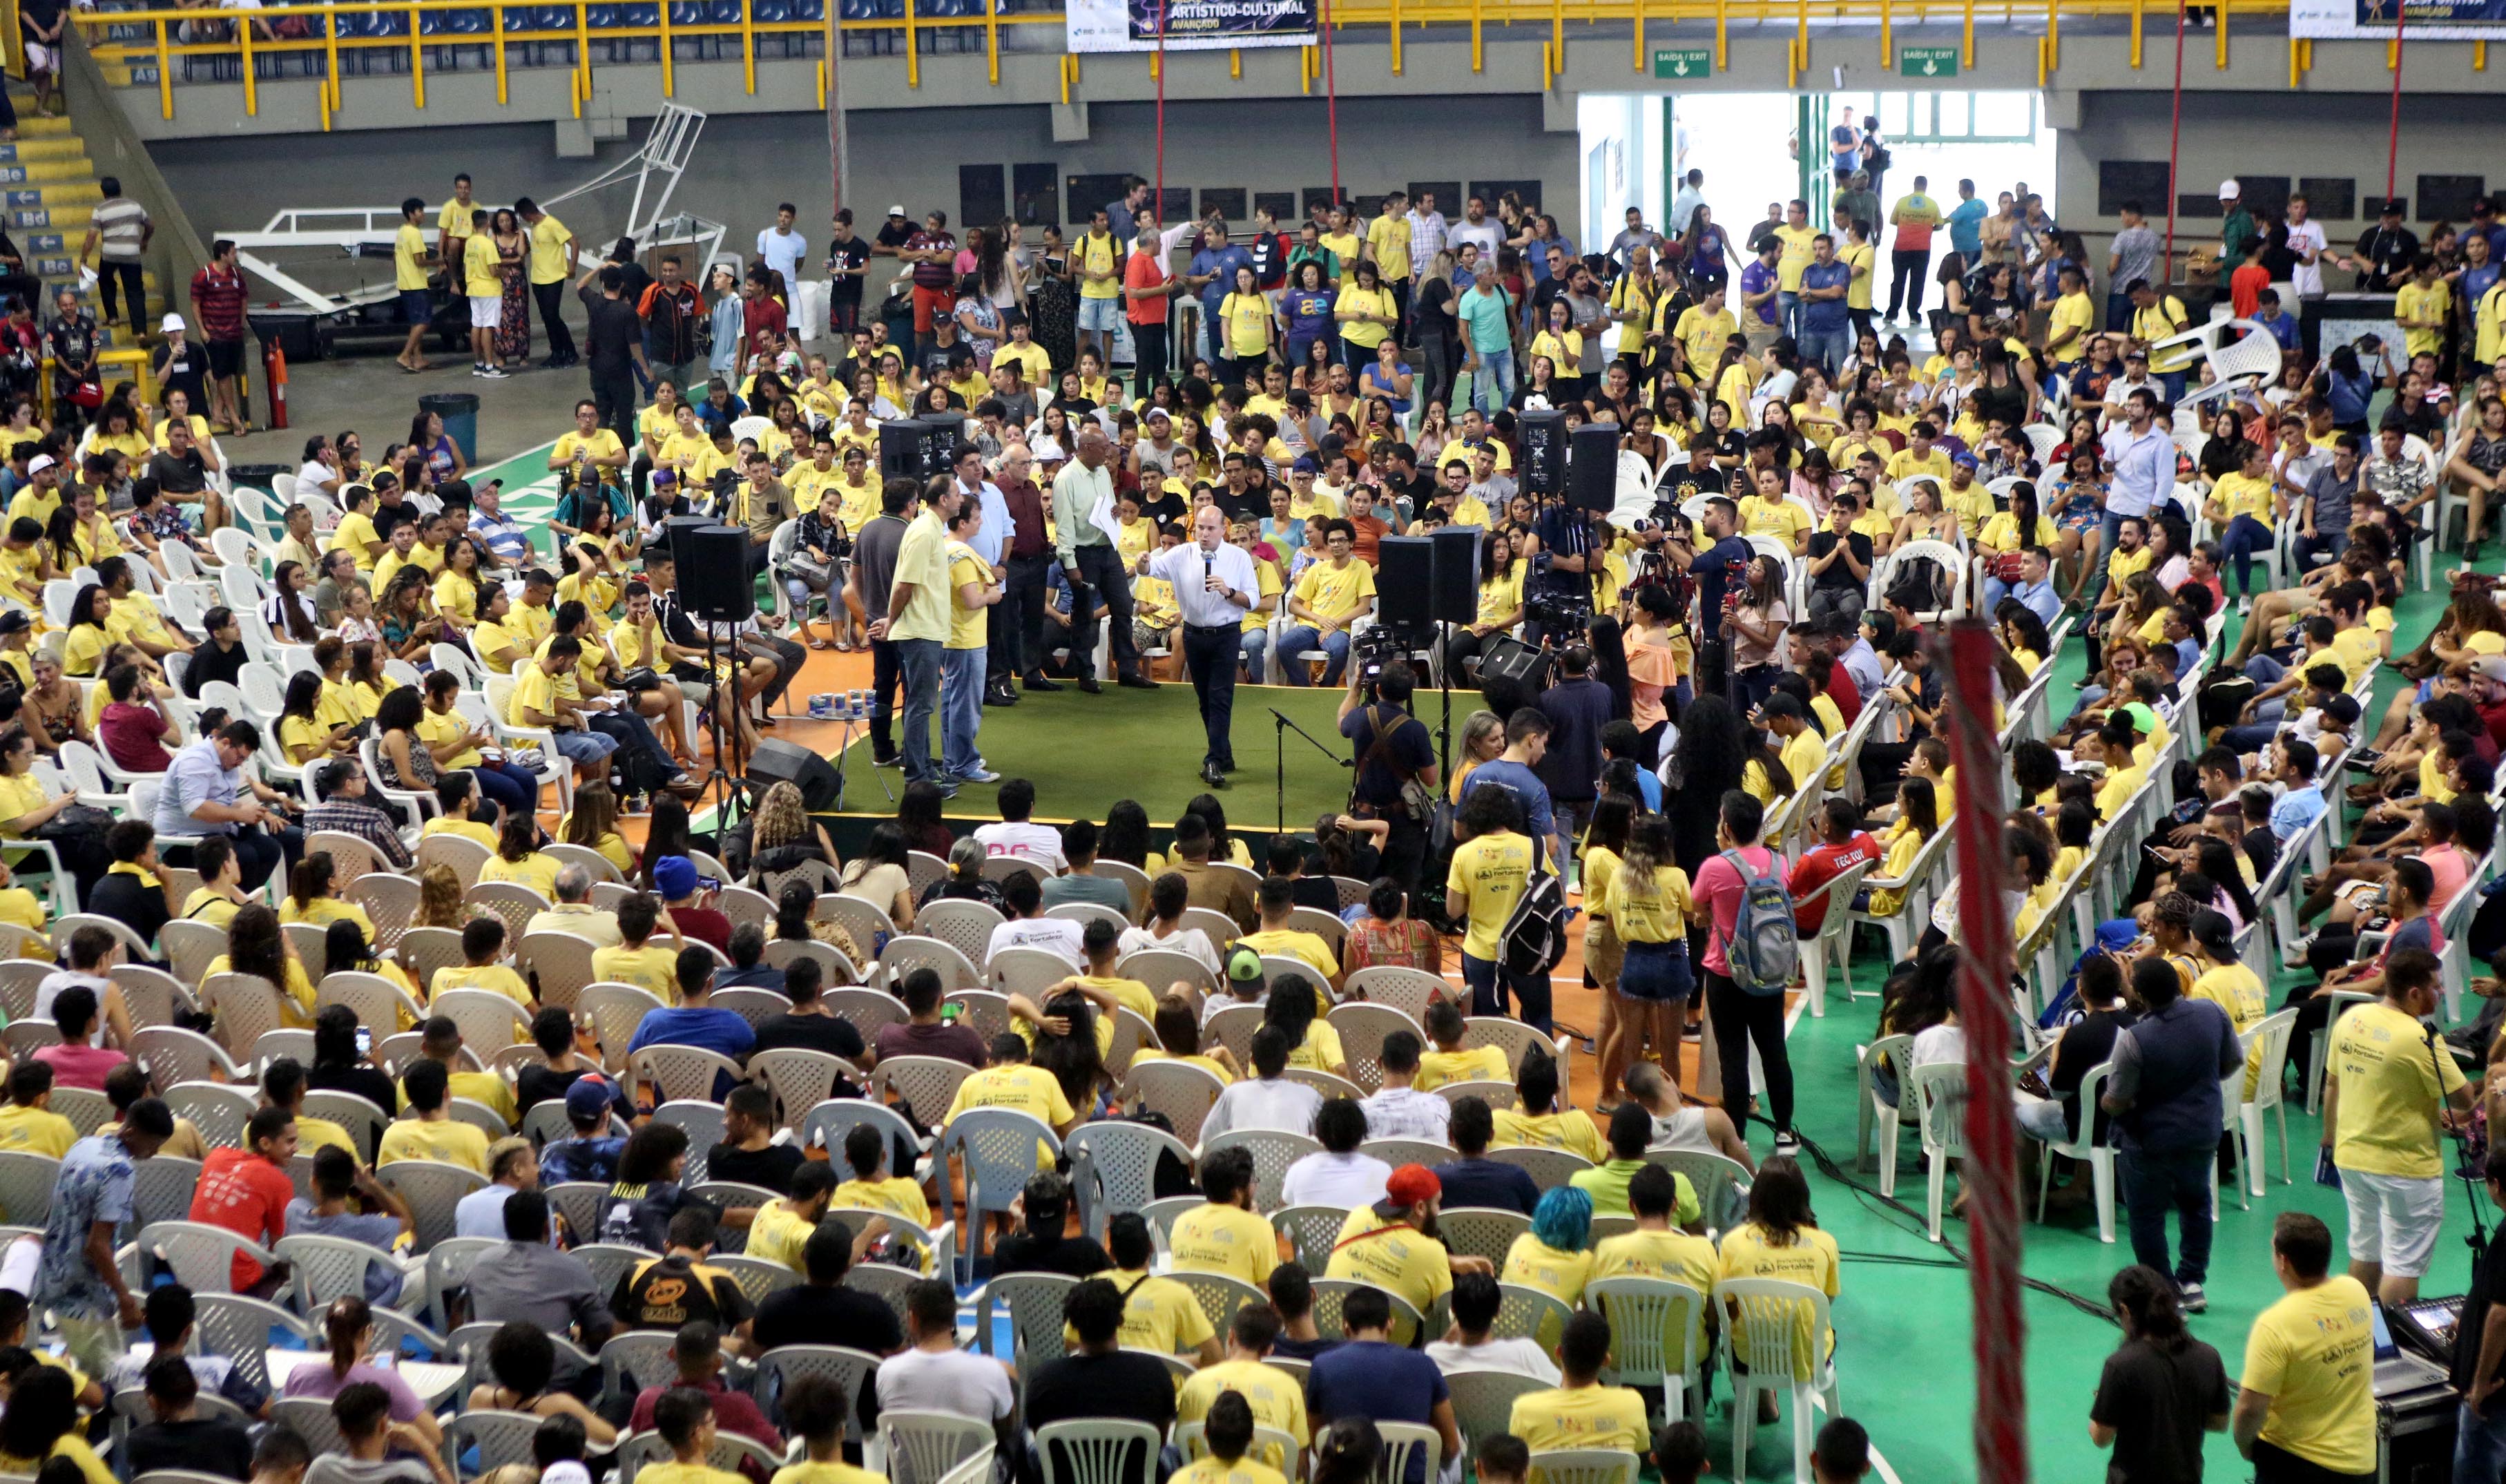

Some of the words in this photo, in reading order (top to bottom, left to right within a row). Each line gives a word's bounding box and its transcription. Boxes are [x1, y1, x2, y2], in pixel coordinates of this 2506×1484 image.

[1171, 1, 1307, 19] ARTÍSTICO-CULTURAL
[1172, 19, 1220, 30] AVANÇADO
[1658, 52, 1684, 61] SAÍDA
[1690, 52, 1708, 61] EXIT
[1904, 50, 1929, 59] SAÍDA
[1935, 50, 1954, 59] EXIT
[1834, 857, 1851, 869] TEC
[1850, 848, 1865, 862] TOY
[1630, 904, 1660, 912] Fortaleza
[1030, 934, 1063, 943] Fortaleza
[2354, 1049, 2383, 1062] Fortaleza
[1191, 1253, 1228, 1264] Fortaleza
[1777, 1262, 1815, 1271] Fortaleza
[1119, 1323, 1152, 1333] ortaleza
